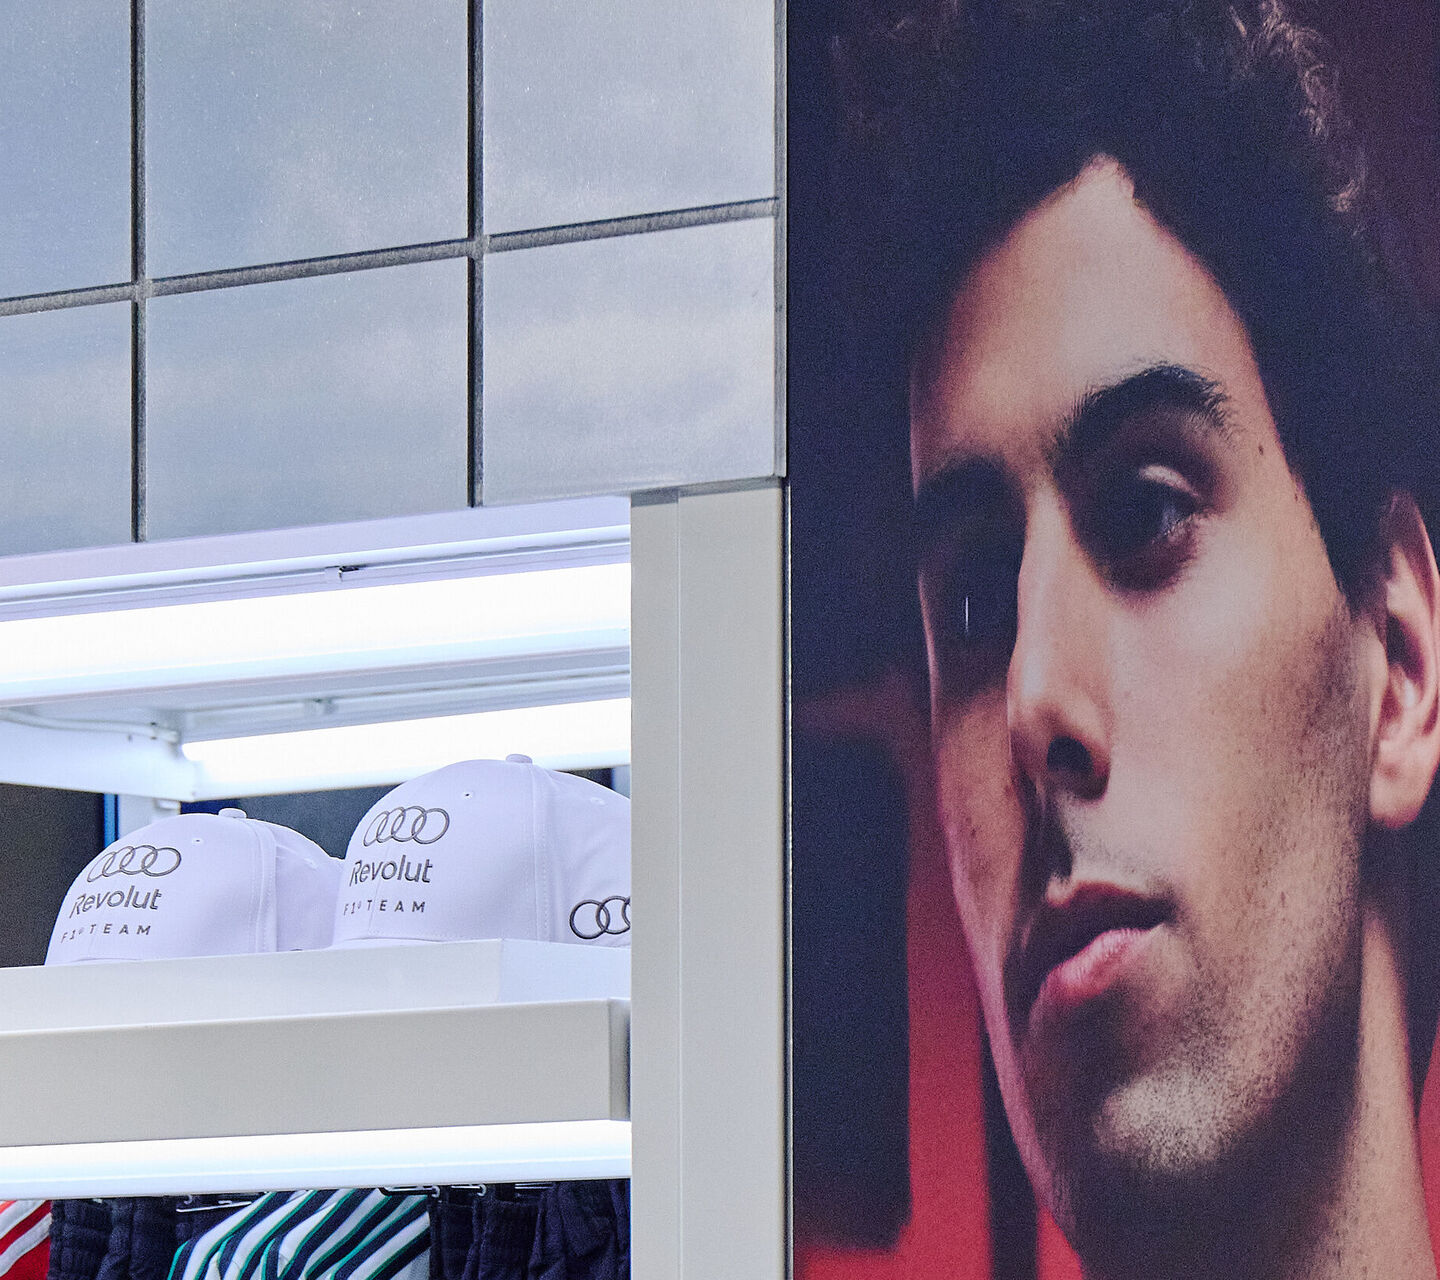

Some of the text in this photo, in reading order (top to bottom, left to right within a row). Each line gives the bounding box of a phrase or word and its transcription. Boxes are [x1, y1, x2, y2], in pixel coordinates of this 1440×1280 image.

[348, 854, 433, 887] Revolut
[68, 885, 163, 919] Revolut
[367, 899, 426, 913] TEAM
[89, 923, 152, 936] TEAM
